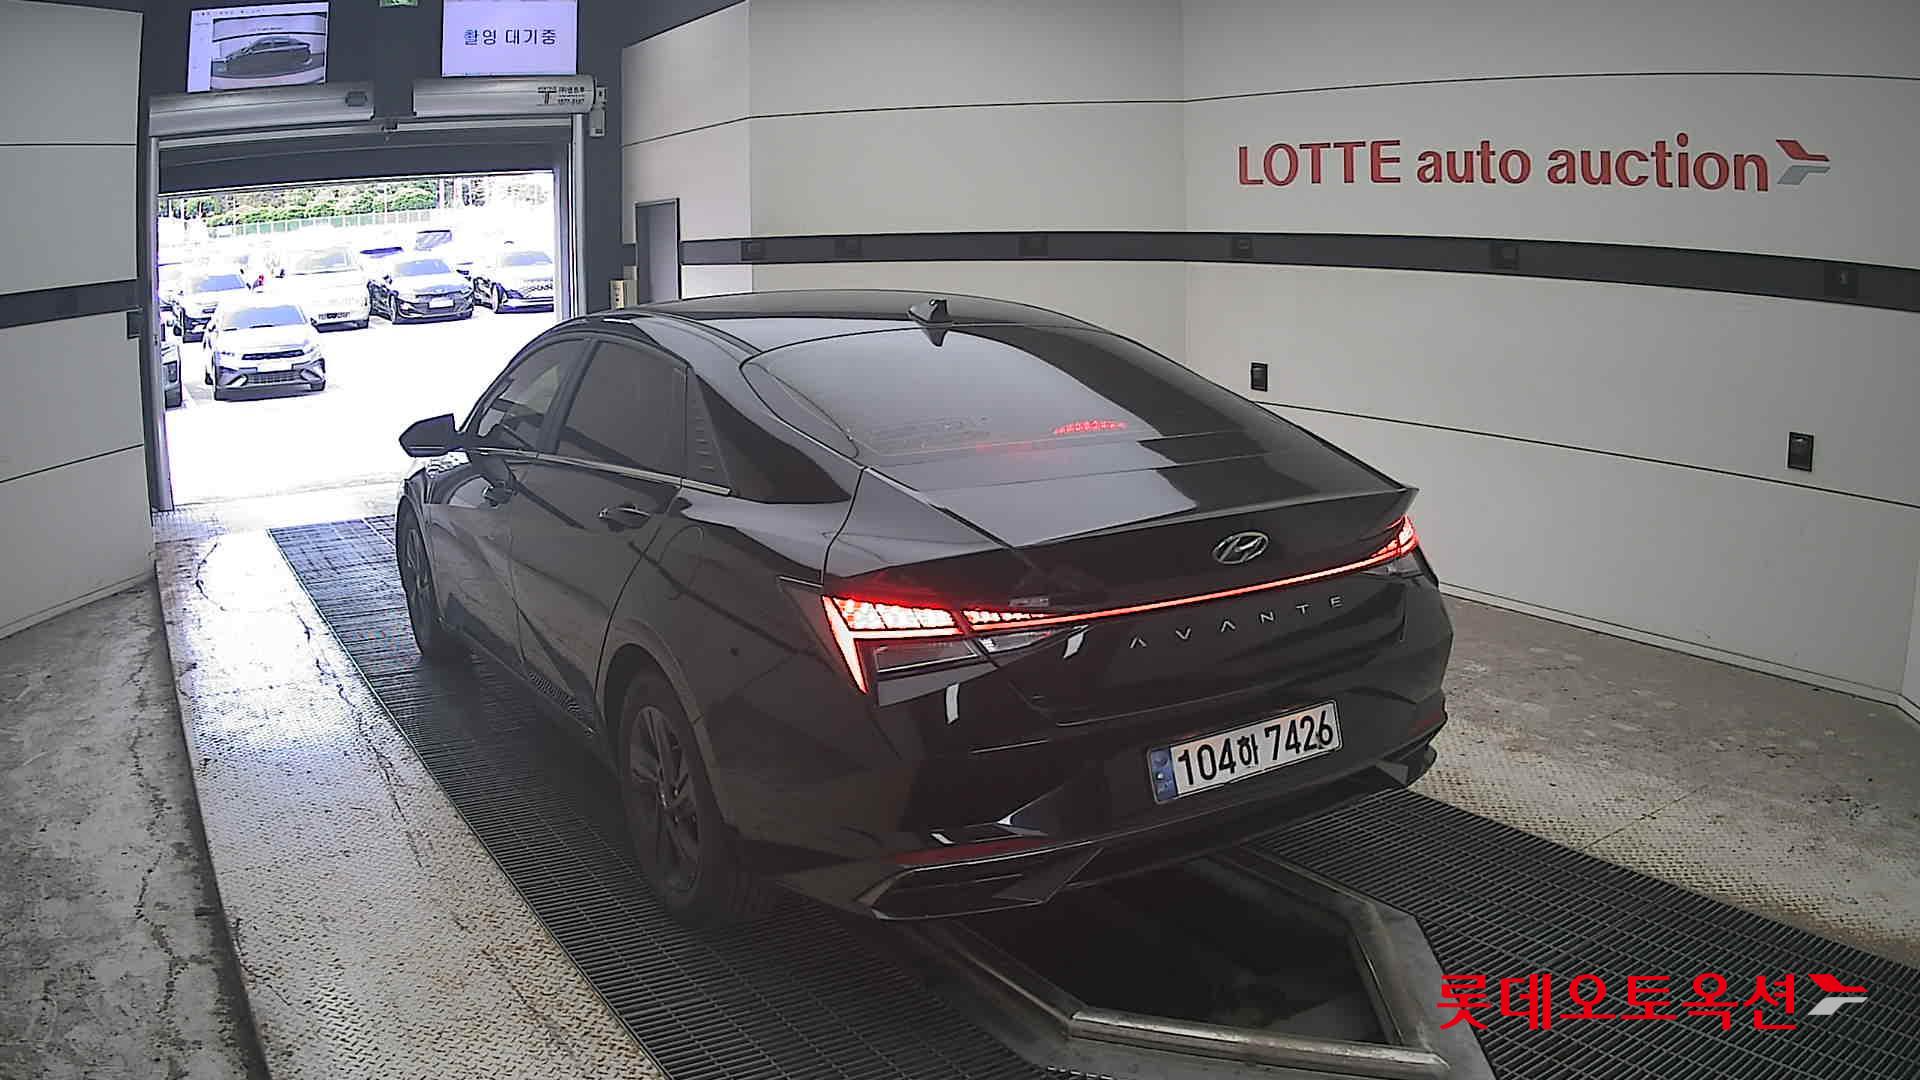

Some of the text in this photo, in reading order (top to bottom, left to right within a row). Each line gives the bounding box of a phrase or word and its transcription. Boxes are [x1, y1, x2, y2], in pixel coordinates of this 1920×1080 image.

[505, 28, 556, 46] 대기중
[1238, 131, 1769, 193] LOTTE auto auction
[1129, 595, 1345, 649] AVANTE
[1177, 710, 1334, 786] 104하 7426
